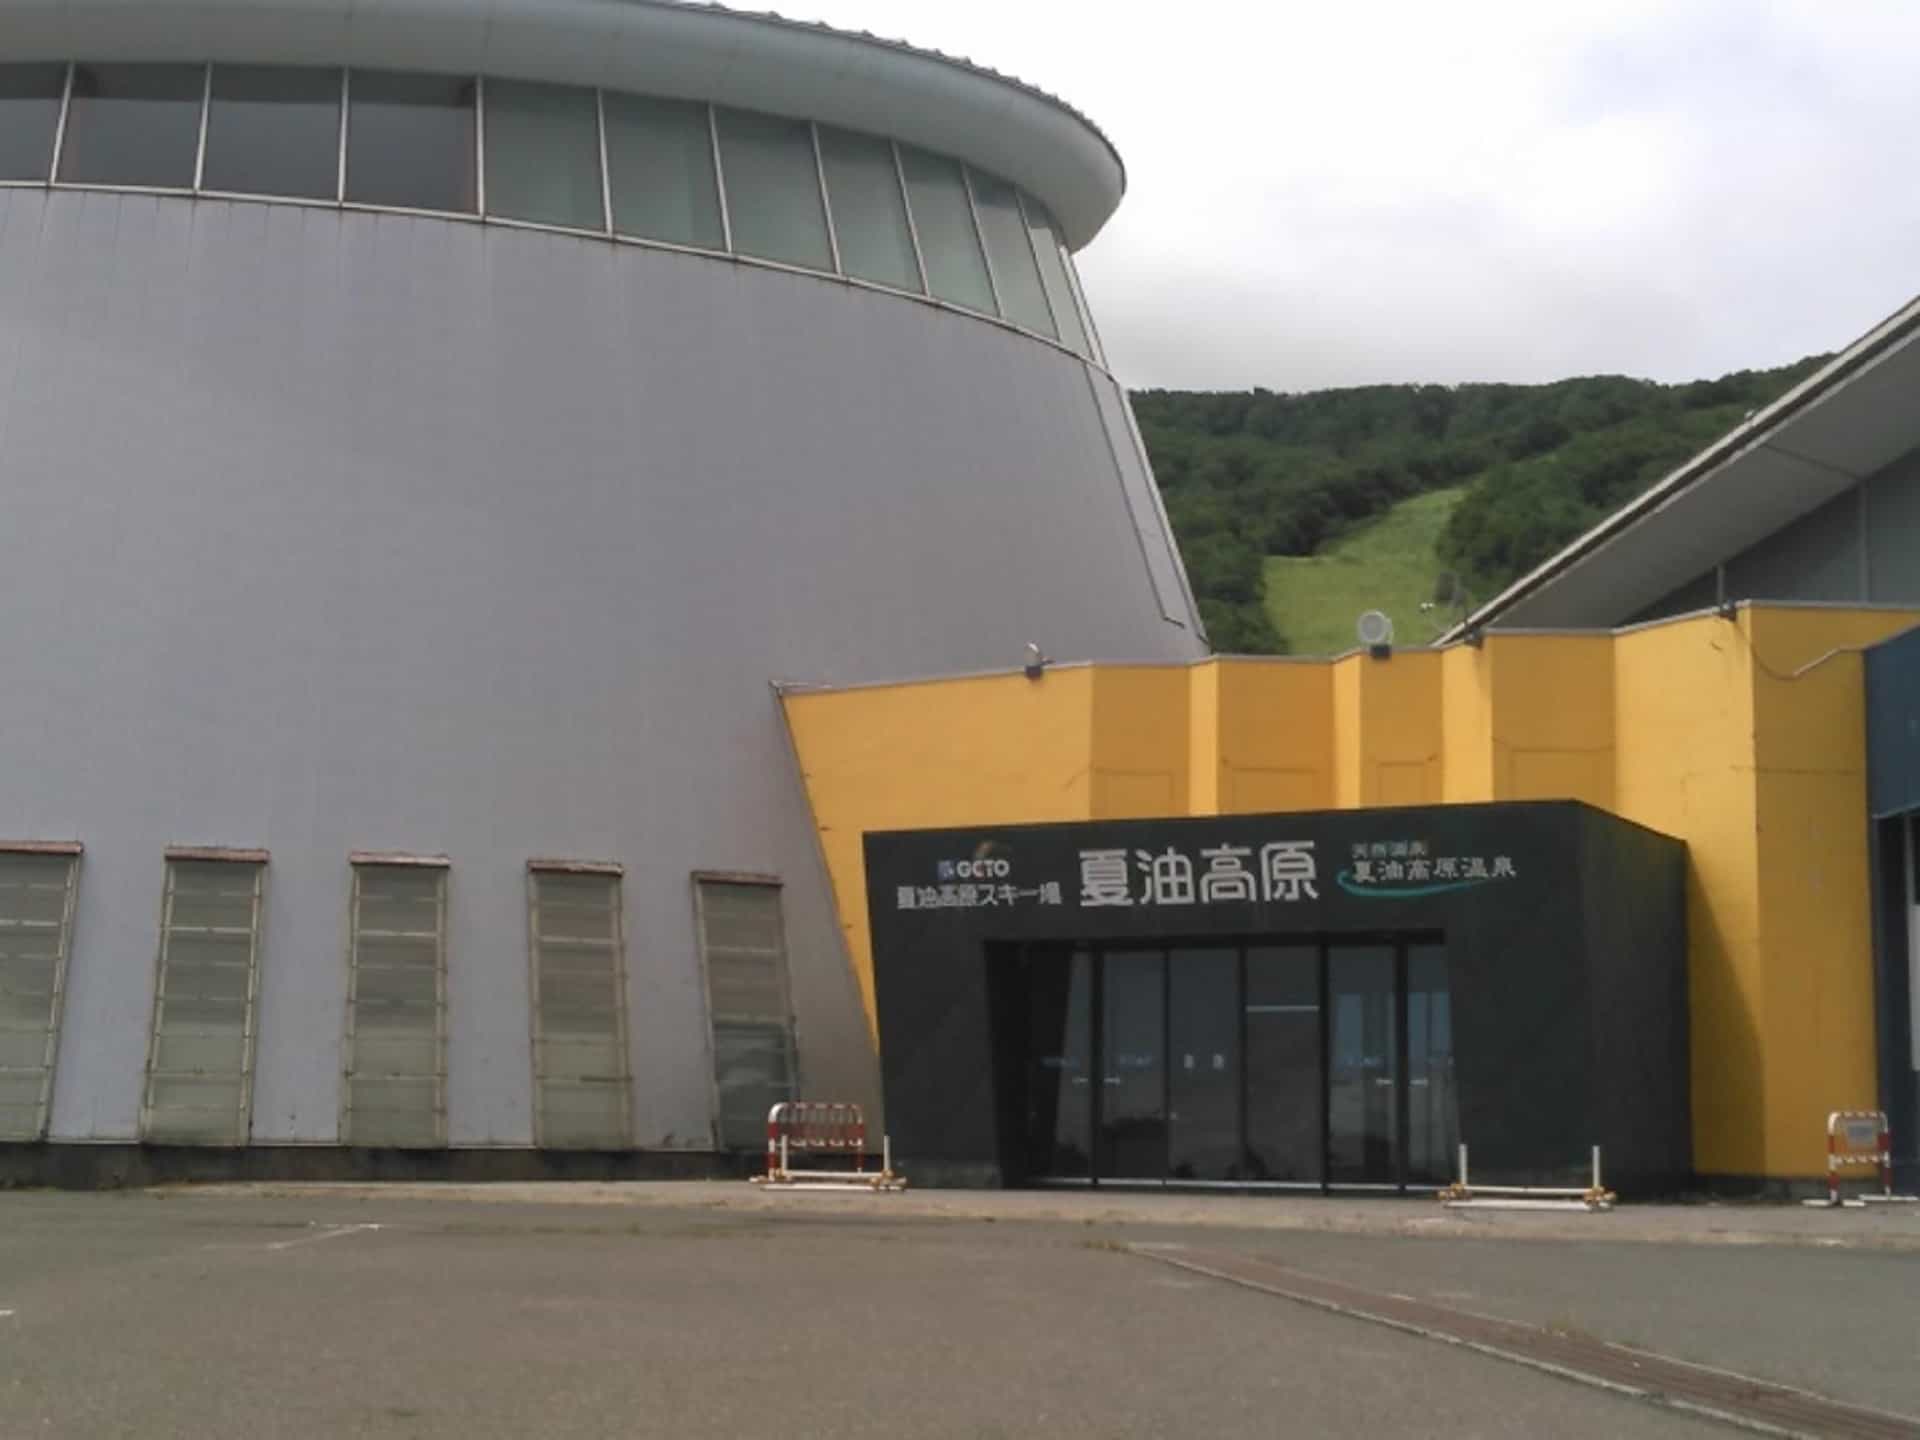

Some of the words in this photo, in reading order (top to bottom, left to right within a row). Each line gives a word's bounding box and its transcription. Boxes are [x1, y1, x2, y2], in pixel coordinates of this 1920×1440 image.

[1079, 840, 1319, 907] 夏油高原
[1352, 854, 1517, 883] 夏油高原温泉
